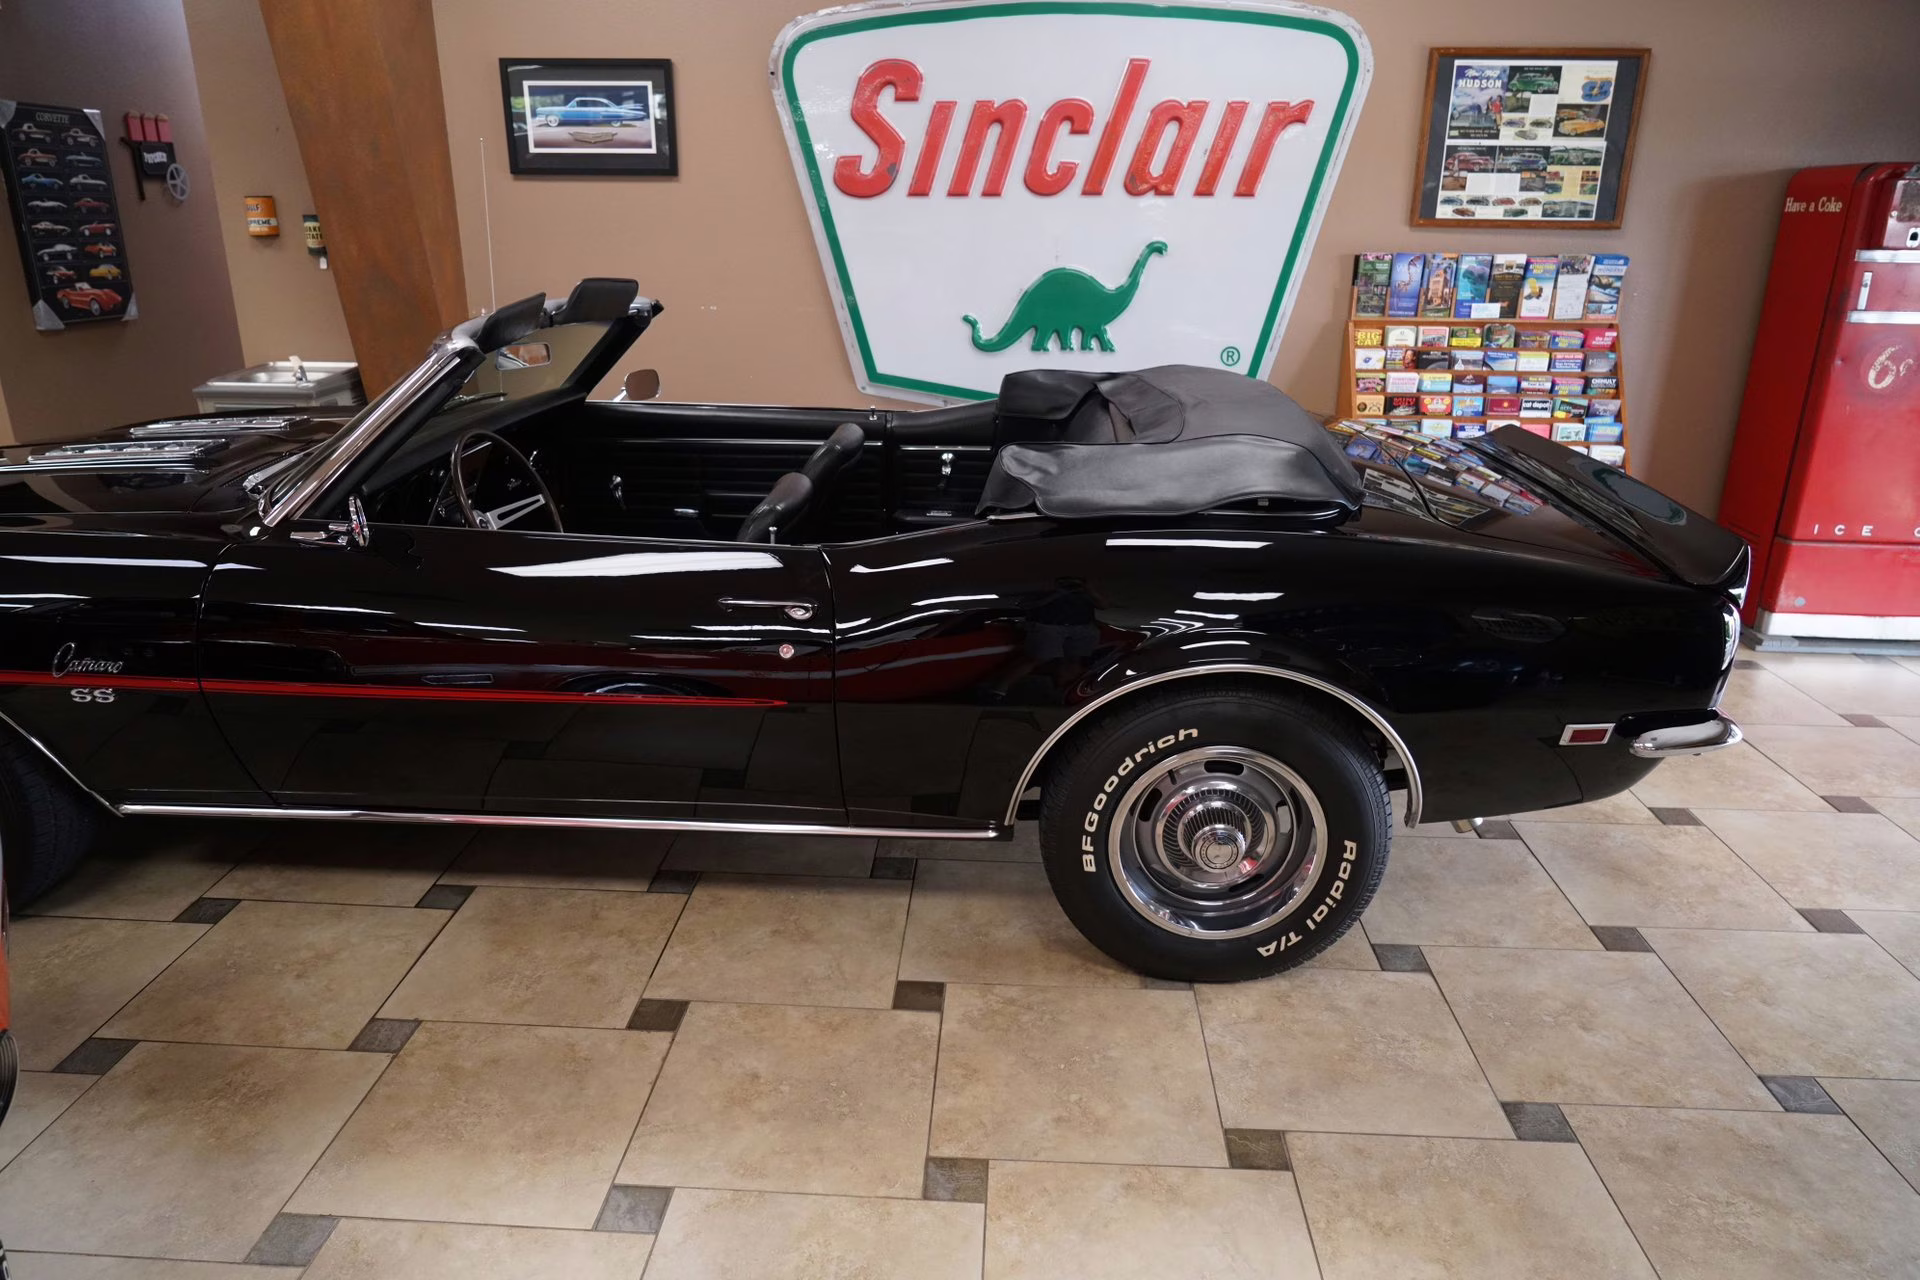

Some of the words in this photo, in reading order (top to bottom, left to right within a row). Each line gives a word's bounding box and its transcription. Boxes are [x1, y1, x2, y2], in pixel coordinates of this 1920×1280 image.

[1458, 79, 1503, 88] HUDSON
[36, 112, 70, 124] CORVETTE
[833, 57, 1314, 198] Sinclair
[1784, 197, 1806, 212] Have
[1809, 202, 1815, 212] a
[1818, 196, 1843, 212] Coke
[1358, 331, 1380, 340] BIG
[1532, 401, 1550, 409] depot
[1814, 524, 1874, 537] ICE
[52, 642, 124, 677] Camaro
[70, 687, 115, 703] SS
[1082, 728, 1199, 873] BFGoodrich
[1305, 839, 1358, 931] Radial
[1256, 931, 1304, 957] T/A
